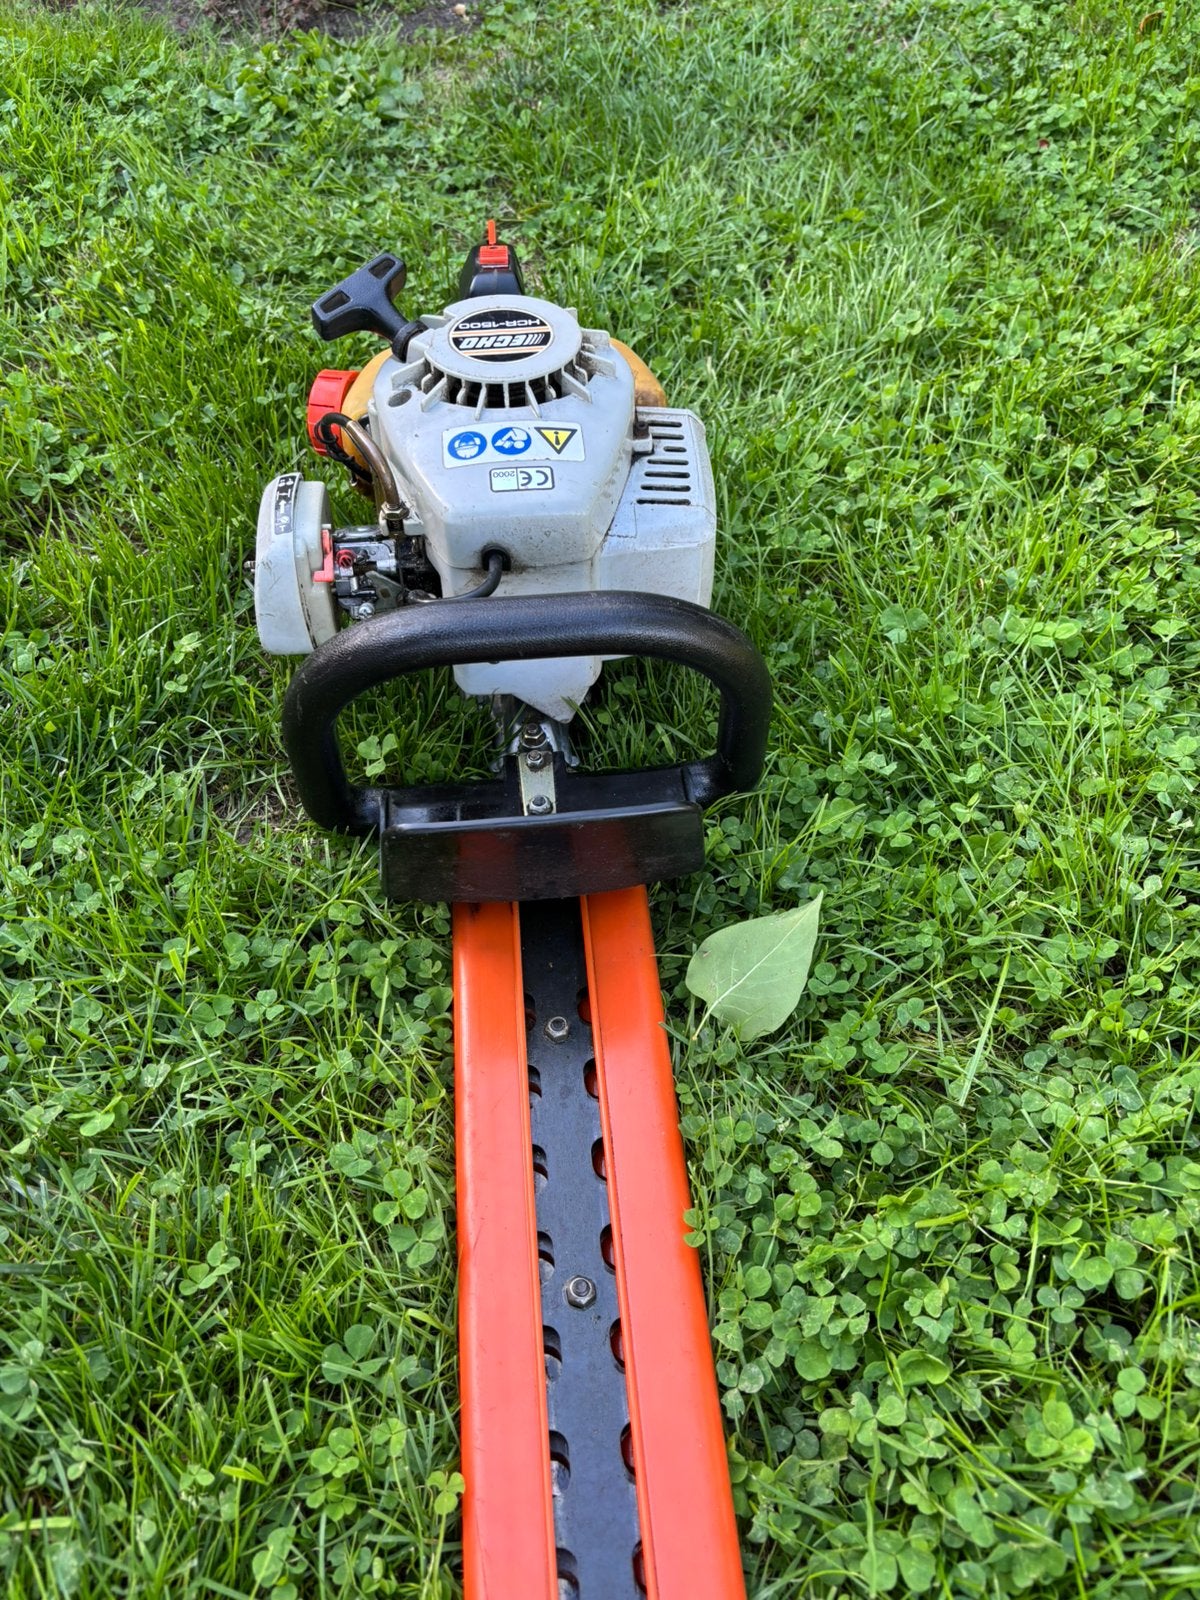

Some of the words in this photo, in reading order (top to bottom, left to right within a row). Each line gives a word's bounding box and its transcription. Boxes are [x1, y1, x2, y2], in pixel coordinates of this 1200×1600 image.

[458, 319, 540, 329] HCR-1500
[458, 333, 524, 349] ECHO
[492, 470, 515, 478] 2000
[519, 470, 549, 486] CE
